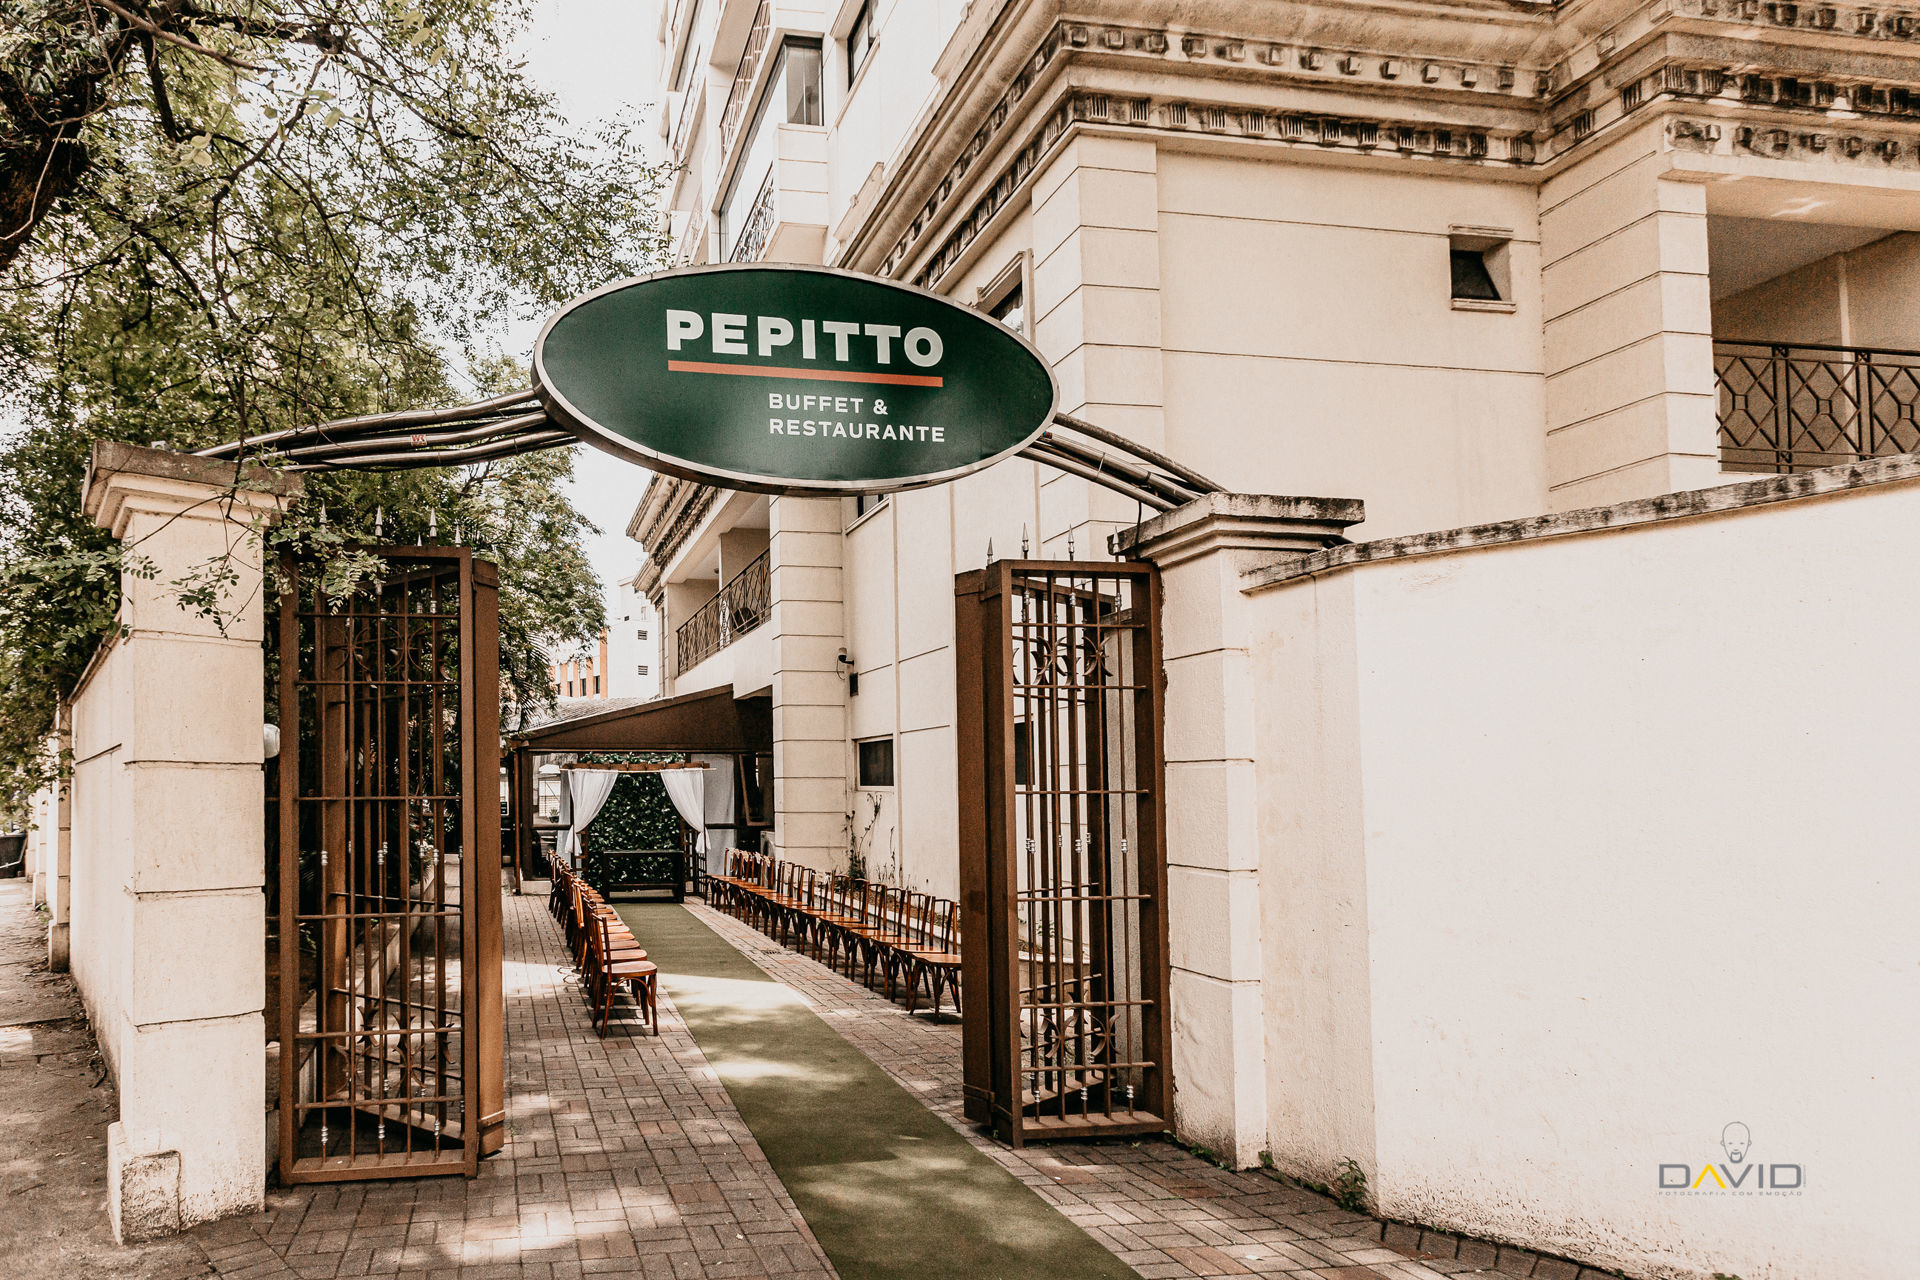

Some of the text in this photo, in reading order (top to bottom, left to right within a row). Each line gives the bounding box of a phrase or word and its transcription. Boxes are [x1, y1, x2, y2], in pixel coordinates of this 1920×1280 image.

[666, 309, 944, 367] PEPITTO
[768, 393, 888, 415] BUFFET &
[768, 418, 945, 443] RESTAURANTE
